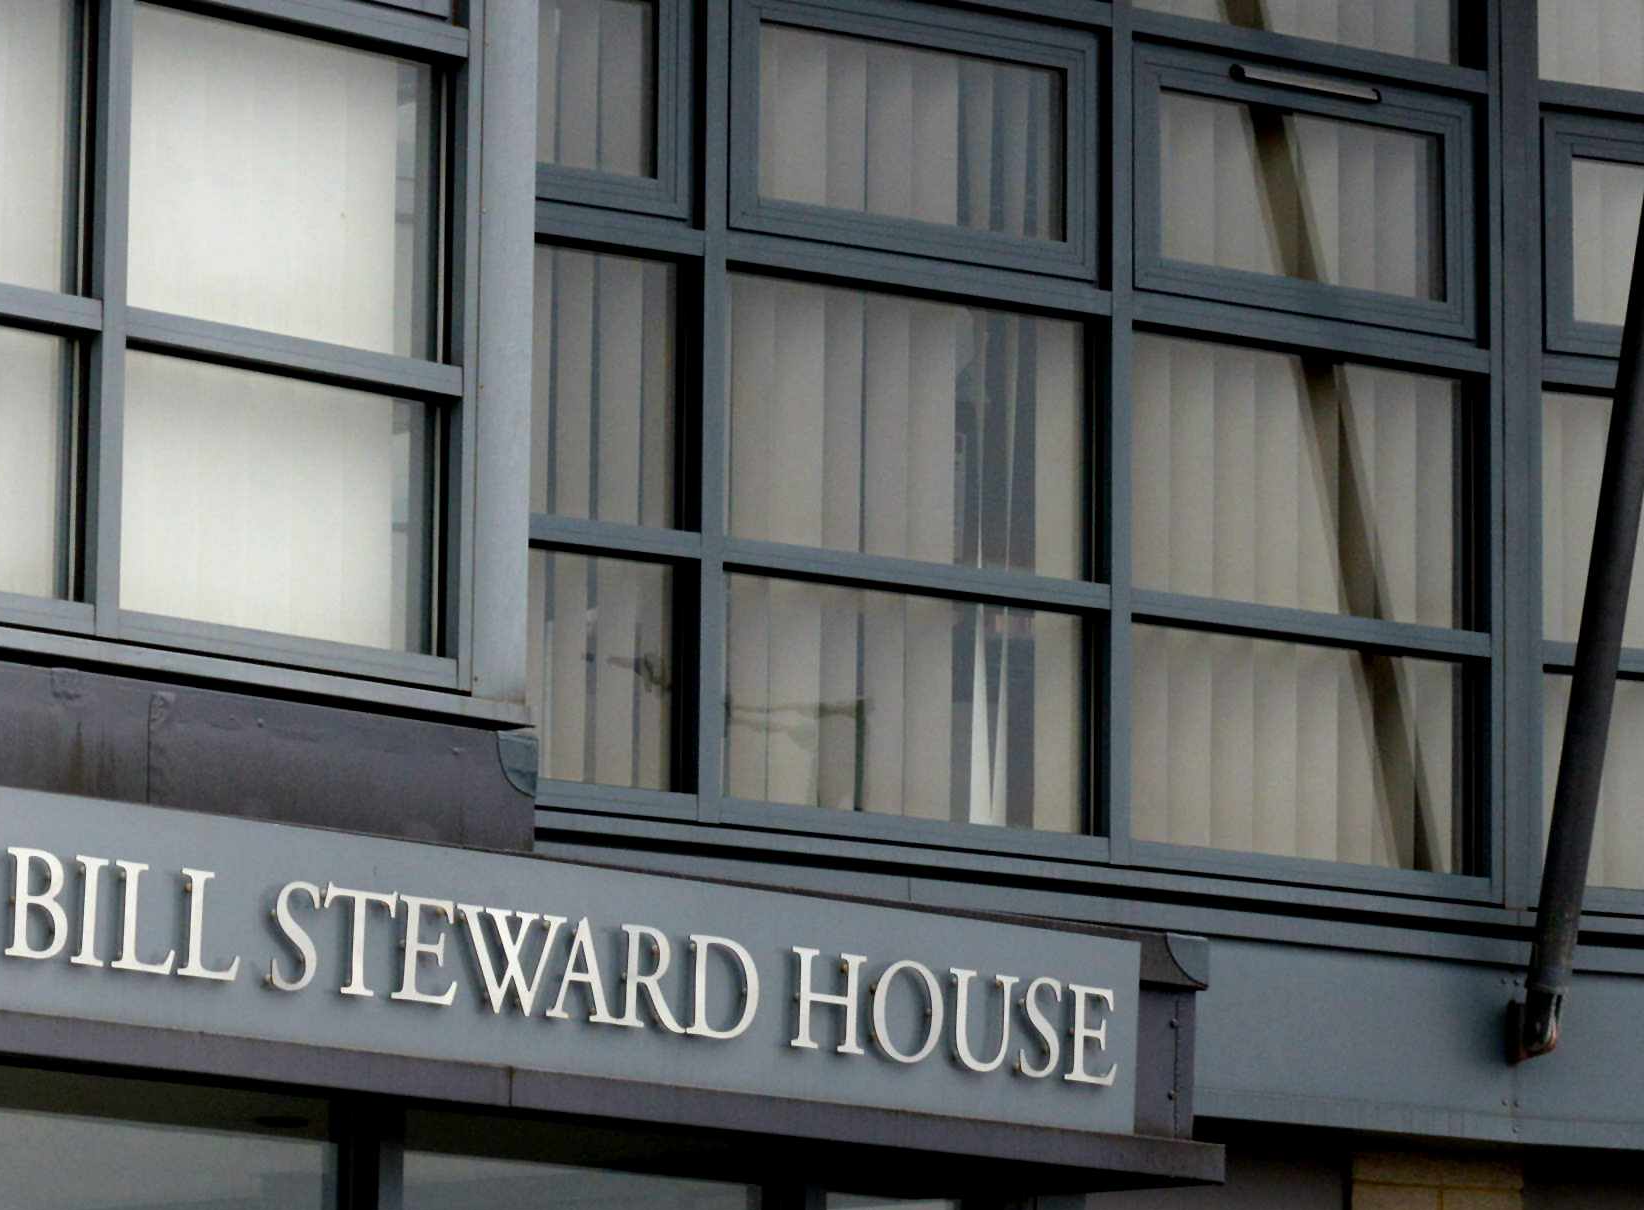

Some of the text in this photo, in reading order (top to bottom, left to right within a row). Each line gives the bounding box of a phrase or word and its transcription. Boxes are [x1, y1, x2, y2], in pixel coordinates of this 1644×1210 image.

[4, 845, 1118, 1086] BILL STEWARD HOUSE
